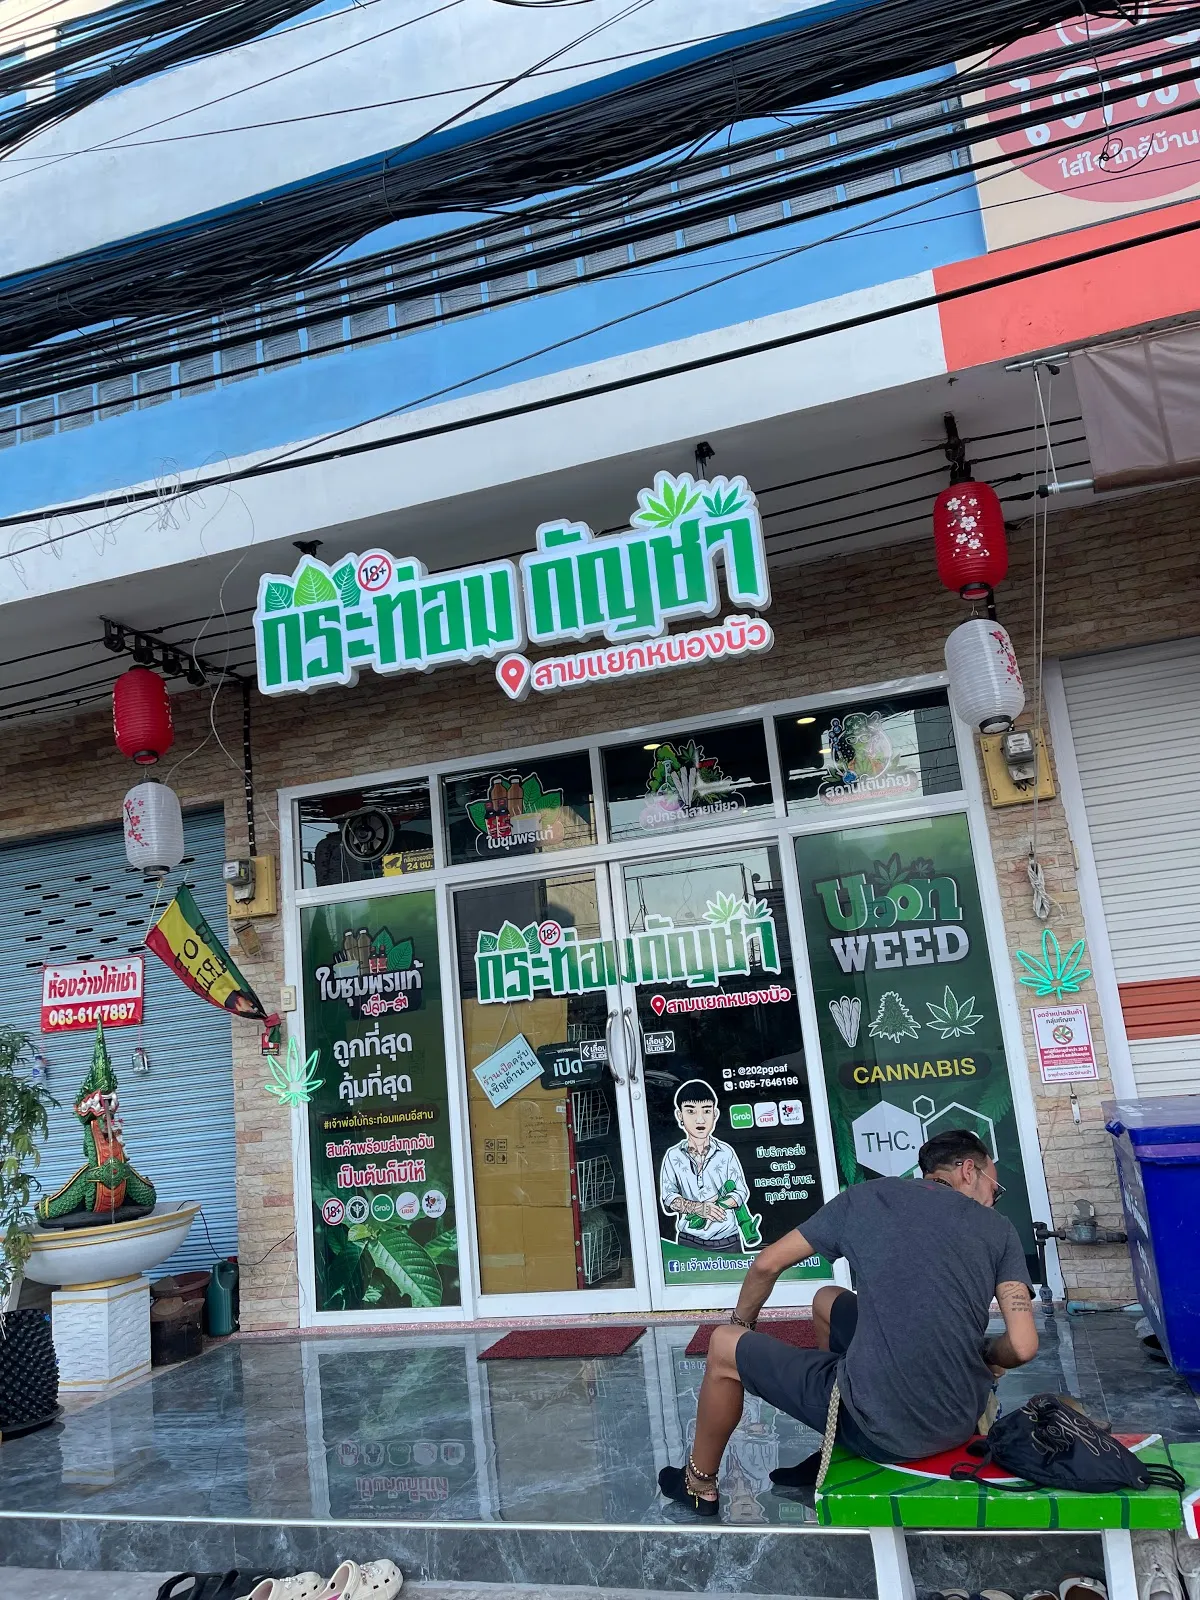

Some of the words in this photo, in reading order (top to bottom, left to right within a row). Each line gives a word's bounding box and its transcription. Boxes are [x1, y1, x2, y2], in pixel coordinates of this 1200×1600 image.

[1110, 128, 1200, 164] ใกล้บ้าน
[361, 564, 388, 584] 18+
[262, 565, 516, 688] กระท่อม
[527, 517, 760, 640] กัญชา
[535, 617, 768, 683] สามแยกหนองบัว
[647, 799, 739, 827] อุปกรณ์สายเขียว
[486, 824, 554, 850] ใบชุมพรแท้
[406, 862, 418, 871] 24
[815, 872, 963, 933] Ubon
[477, 931, 637, 1004] กระท่อม
[638, 914, 782, 987] กัญชา
[830, 924, 970, 975] WEED
[48, 964, 138, 999] ห้องว่างให้เช่า
[315, 959, 424, 1007] ใบชุมพรแท้
[666, 984, 793, 1014] สามแยกหนองบัว
[48, 1002, 136, 1026] 063-6147887
[333, 1022, 413, 1068] ถูกที่สุด
[553, 1057, 583, 1077] เปิด
[737, 1063, 788, 1076] @202pgcaf
[853, 1057, 977, 1085] CANNABIS
[338, 1064, 413, 1106] คุ้มที่สุด
[739, 1076, 799, 1090] 095-7646196
[732, 1112, 751, 1121] Grab
[326, 1133, 434, 1157] สินค้าพร้อมส่งทุกวัน
[756, 1143, 806, 1158] มีบริการส่ง
[861, 1131, 916, 1152] THC.
[337, 1160, 426, 1188] เป็นต้นก็มีให้
[770, 1160, 796, 1171] Grab
[754, 1174, 791, 1188] และรถตู้
[325, 1205, 341, 1218] 18+
[374, 1204, 391, 1212] Grab
